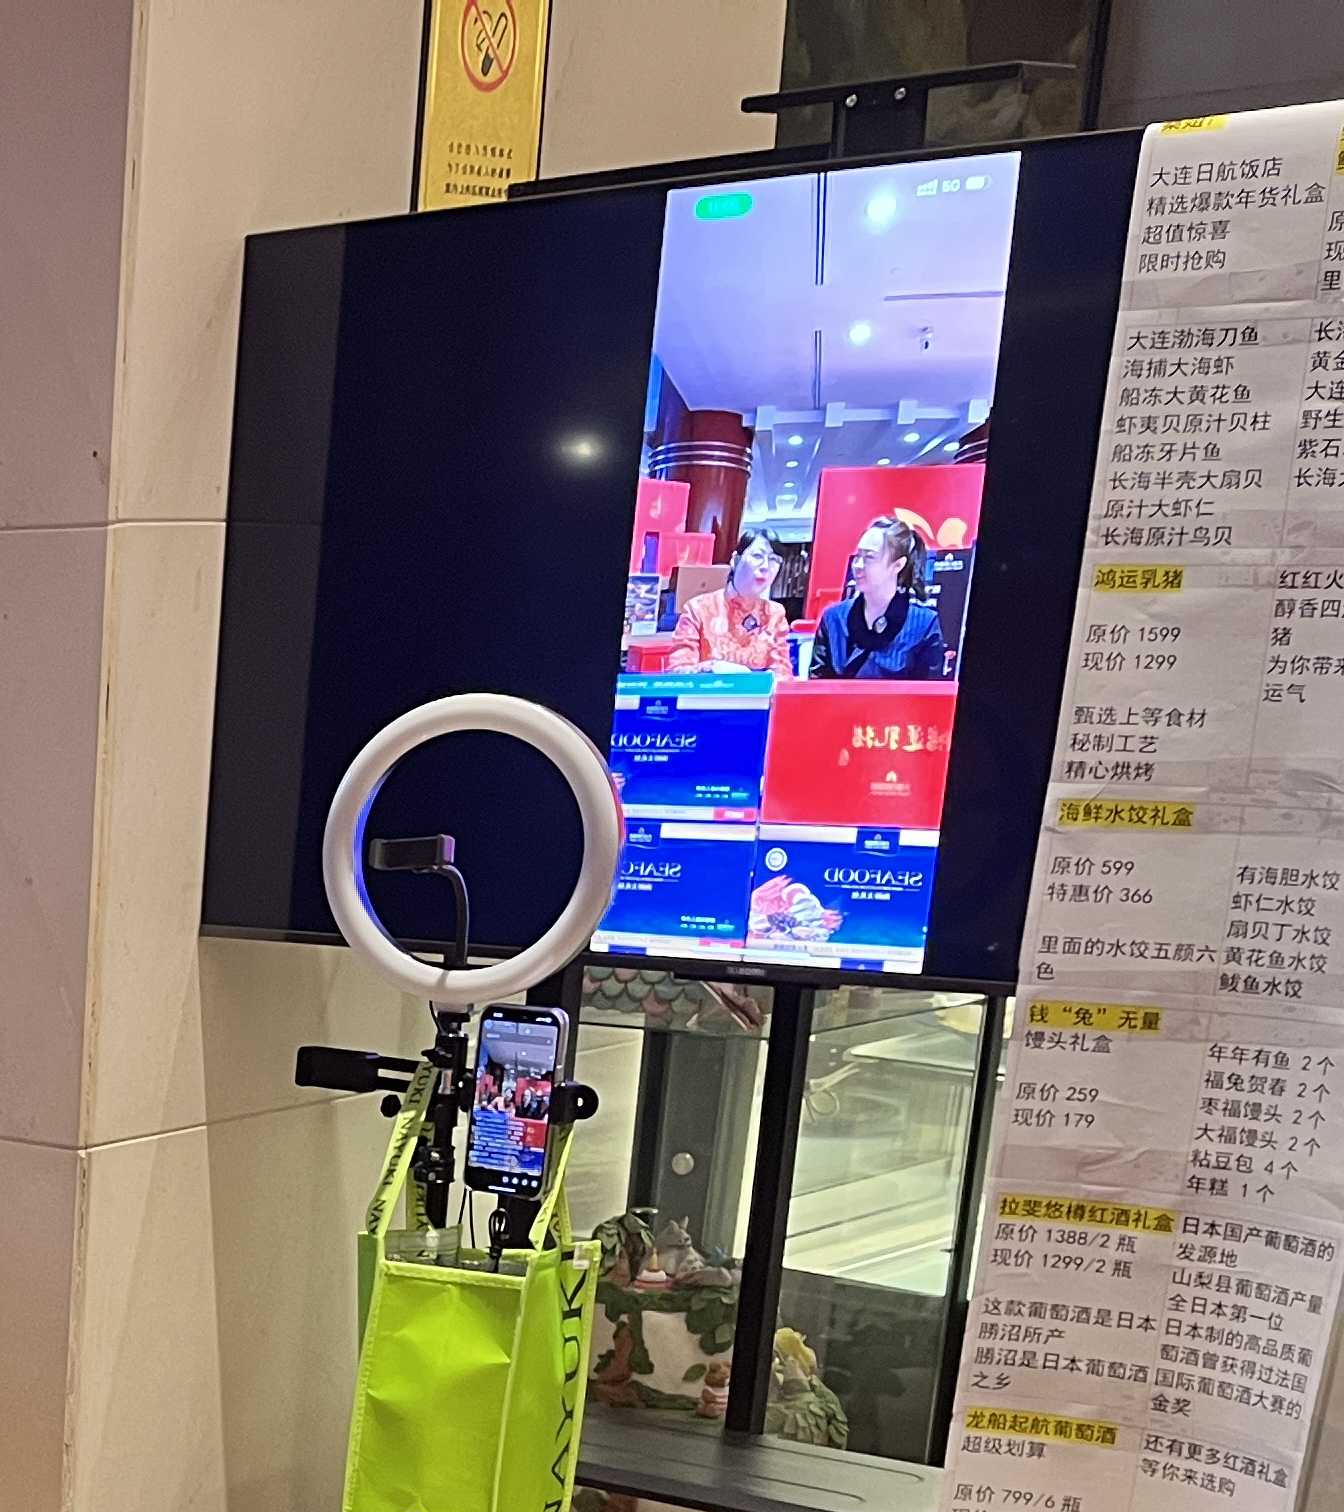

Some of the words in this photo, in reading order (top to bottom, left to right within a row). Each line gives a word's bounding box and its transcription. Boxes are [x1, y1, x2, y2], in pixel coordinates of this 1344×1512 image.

[1150, 157, 1284, 187] 大连日航饭店
[1147, 182, 1326, 216] 精选爆款年货礼盒
[1141, 219, 1231, 245] 超值惊喜
[1138, 249, 1226, 273] 限时抢购
[1127, 326, 1260, 351] 大连渤海刀鱼
[1122, 356, 1234, 379] 海捕大海虾
[1118, 384, 1251, 407] 船冻大黄花鱼
[1111, 441, 1223, 463] 船冻牙片鱼
[1109, 469, 1262, 491] 长海半壳大扇贝
[1104, 498, 1215, 519] 原汁大虾仁
[1102, 526, 1232, 547] 长海原汁鸟贝
[1094, 568, 1184, 589] 鸿运乳猪
[1274, 597, 1344, 619] 醇香四
[1262, 683, 1306, 703] 运气
[1073, 706, 1207, 729] 甄选上等食材
[1070, 733, 1159, 754] 秘制工艺
[1065, 760, 1155, 782] 精心烘烤
[1058, 802, 1194, 827] 海鲜水饺礼盒
[1236, 865, 1342, 891] 有海胆水饺
[1230, 892, 1317, 917] 虾仁水饺
[1226, 920, 1332, 947] 扇贝丁水饺
[1039, 936, 1217, 964] 里面的水饺五颜六
[1223, 947, 1328, 975] 黄花鱼水饺
[1037, 963, 1056, 981] 色
[1219, 973, 1303, 1000] 鲅鱼水饺
[1024, 1030, 1113, 1054] 馒头礼盒
[1182, 1215, 1335, 1263] 日本国产葡萄酒的
[1176, 1242, 1238, 1269] 发源地
[1172, 1268, 1325, 1315] 山梨县葡萄酒产量
[983, 1297, 1158, 1333] 这款葡萄酒是日本
[1167, 1294, 1285, 1332] 全日本第一位
[1165, 1318, 1312, 1368] 日本制的高品质葡
[971, 1371, 1011, 1390] 之乡
[1160, 1343, 1308, 1394] 萄酒曾获得过法国
[1150, 1394, 1192, 1418] 金奖
[1154, 1367, 1302, 1420] 国际葡萄酒大赛的
[966, 1409, 1117, 1446] 龙船起航葡萄酒
[961, 1435, 1047, 1460] 超级划算
[1144, 1433, 1290, 1490] 还有更多红酒礼盒
[1140, 1458, 1236, 1498] 等你来选购
